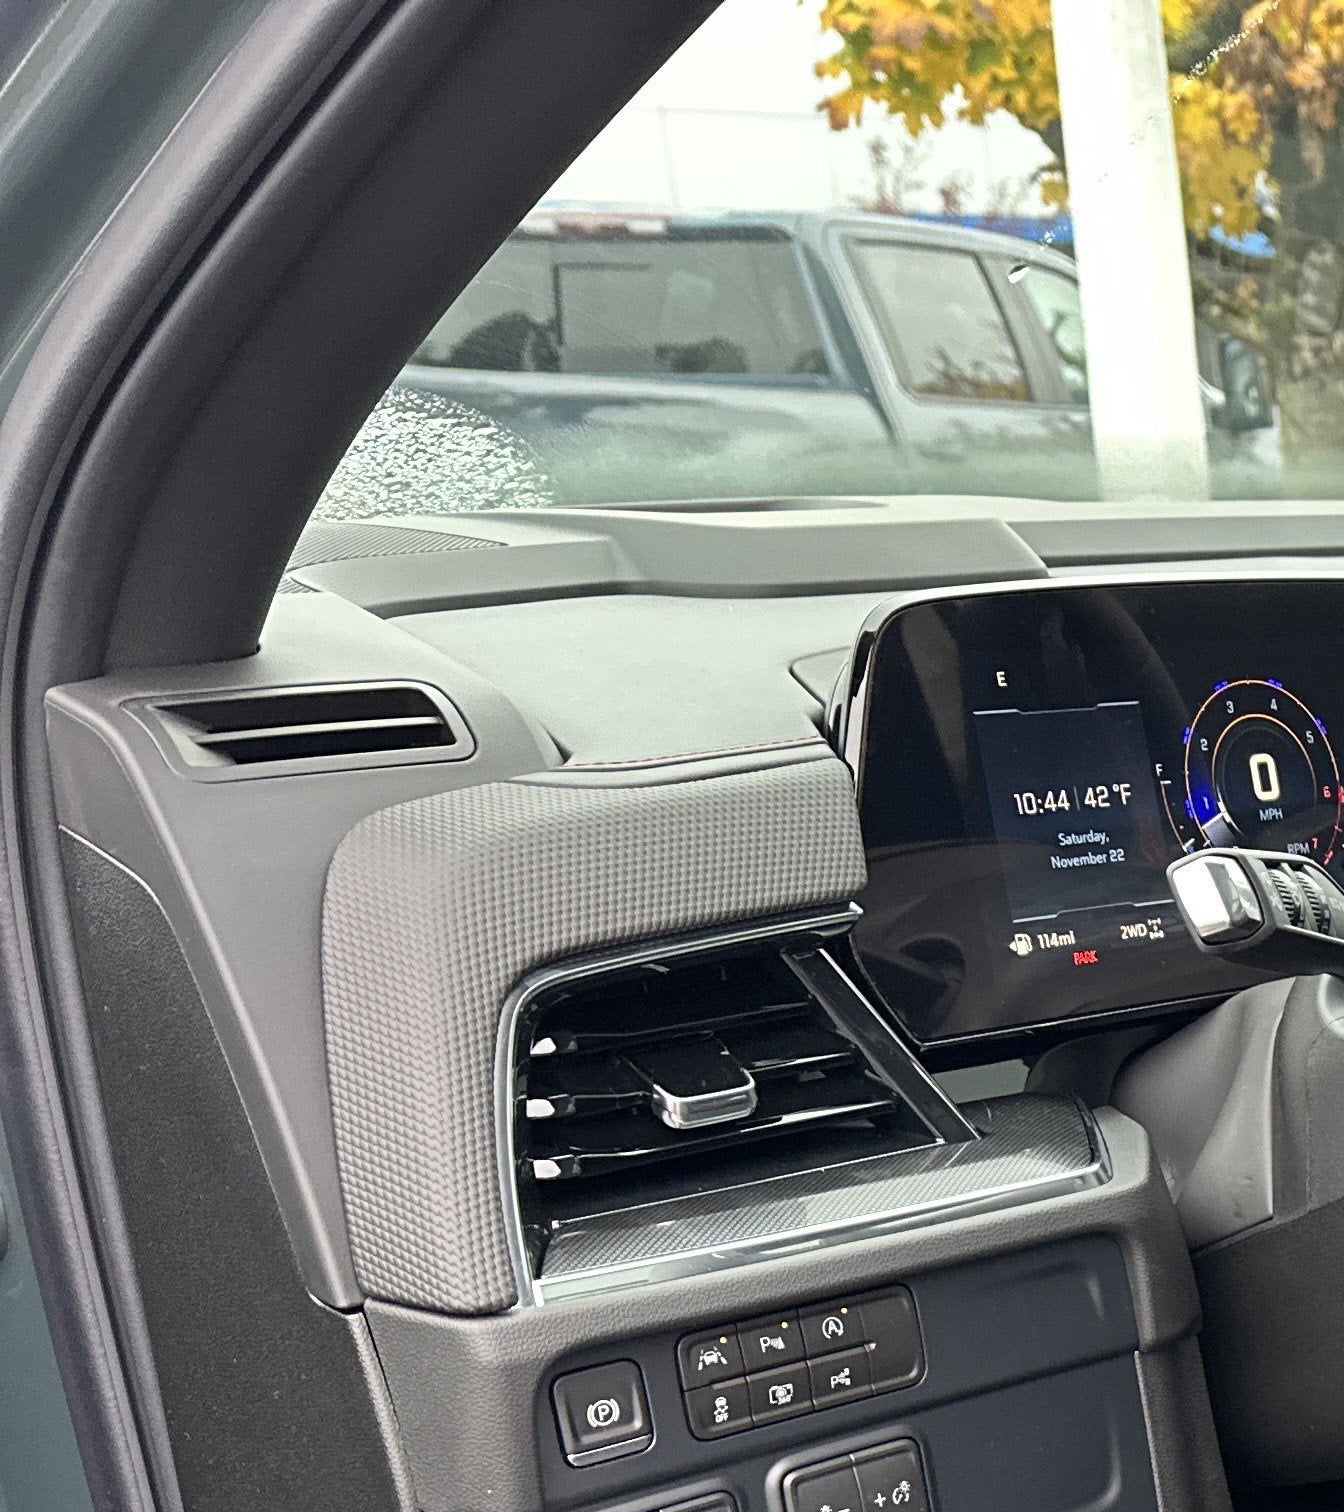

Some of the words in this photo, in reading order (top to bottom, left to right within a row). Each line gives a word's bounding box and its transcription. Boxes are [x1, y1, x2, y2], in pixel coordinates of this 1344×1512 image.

[1226, 700, 1235, 714] 3
[1270, 698, 1278, 711] 4
[1305, 730, 1315, 745] 5
[1200, 738, 1209, 752] 2
[1155, 763, 1163, 778] F
[1249, 752, 1281, 802] 0
[1323, 785, 1332, 799] 6
[1013, 789, 1071, 815] 10:44
[1203, 796, 1210, 810] 1
[1259, 807, 1284, 821] MPH
[1058, 828, 1110, 847] Saturday,
[1311, 836, 1319, 850] 7
[1287, 841, 1310, 855] RPM
[1050, 850, 1108, 870] November
[1109, 847, 1126, 862] 22
[1120, 922, 1148, 940] 2WD
[1072, 949, 1099, 967] PARK
